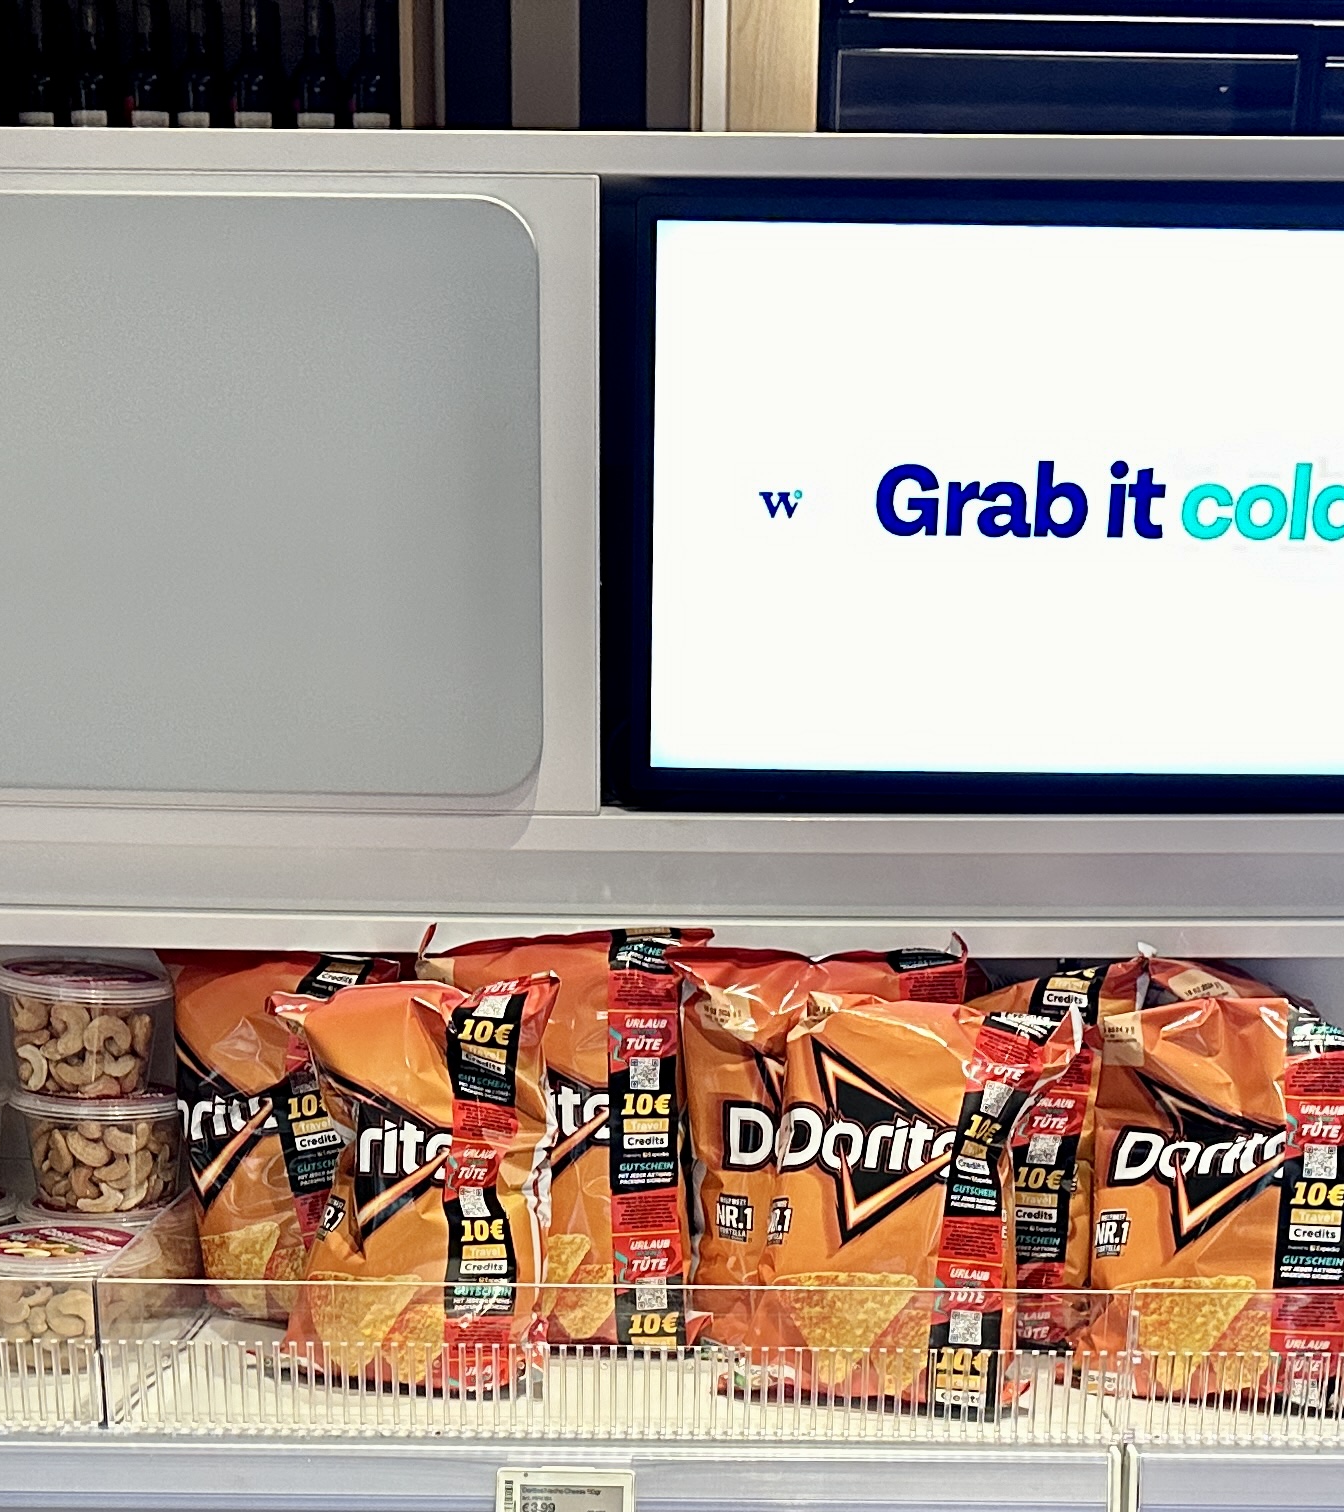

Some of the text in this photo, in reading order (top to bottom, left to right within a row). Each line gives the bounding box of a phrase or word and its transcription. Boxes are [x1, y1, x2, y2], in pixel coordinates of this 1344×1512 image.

[876, 460, 1088, 538] Grab
[1108, 460, 1166, 538] it
[1046, 993, 1083, 1006] Credits
[625, 1018, 667, 1029] URLAUB
[458, 1019, 514, 1045] 10€
[627, 1037, 662, 1051] TÜTE
[621, 1094, 671, 1115] 10€
[631, 1120, 663, 1132] Travel
[1033, 1115, 1066, 1130] TÜTE
[1302, 1123, 1342, 1138] TÜTE
[300, 1133, 338, 1147] Credits
[627, 1135, 664, 1147] Credits
[619, 1161, 674, 1171] GUTSCHEIN
[458, 1166, 487, 1181] TÜTE
[953, 1184, 996, 1198] GUTSCHEIN
[1016, 1208, 1053, 1221] Credits
[1298, 1212, 1334, 1222] Travel
[461, 1220, 504, 1242] 10€
[1294, 1228, 1336, 1239] Credits
[630, 1239, 670, 1250] URLAUB
[464, 1262, 504, 1272] Credits
[632, 1258, 666, 1271] TÜTE
[1282, 1255, 1344, 1266] GUTSCHEIN
[950, 1268, 989, 1281] URLAUB
[628, 1313, 678, 1334] 10€
[1285, 1339, 1330, 1350] URLAUB
